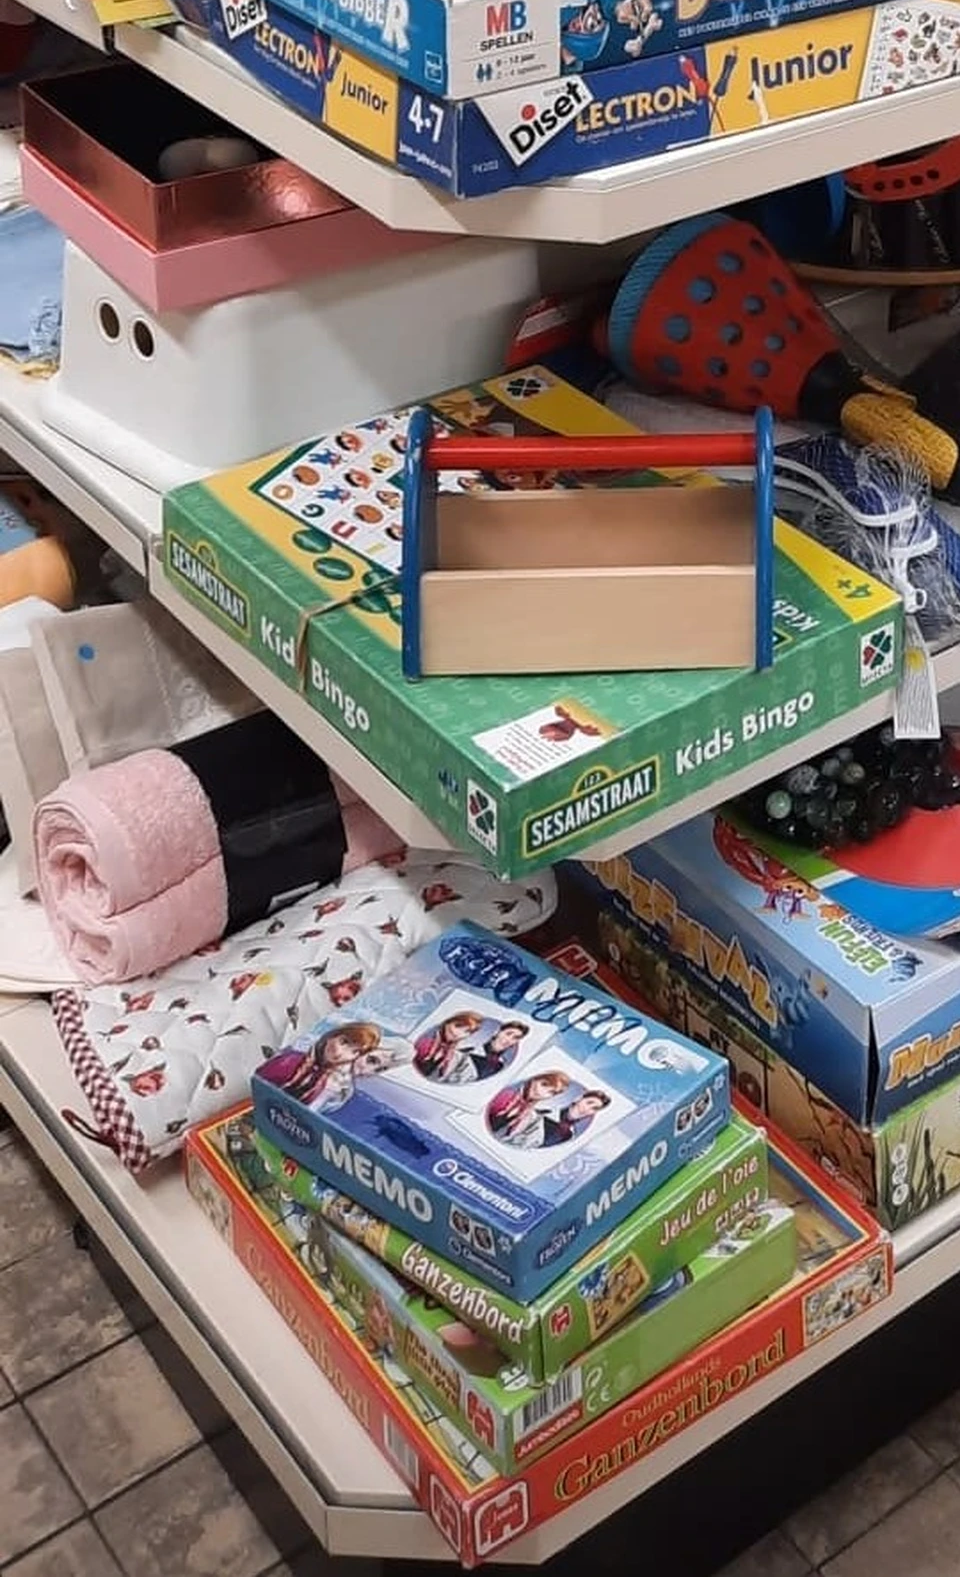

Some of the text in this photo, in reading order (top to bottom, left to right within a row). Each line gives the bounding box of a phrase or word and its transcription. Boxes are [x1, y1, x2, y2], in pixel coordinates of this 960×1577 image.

[480, 30, 534, 52] SPELLEN
[486, 0, 527, 36] MB
[339, 77, 390, 116] Junior
[510, 79, 581, 155] Diset
[576, 85, 698, 134] LECTRON
[751, 40, 853, 101] Junior
[172, 541, 245, 626] SESAMSTRAAT
[261, 616, 370, 733] Kid Bingo
[675, 691, 815, 776] Kids Bingo
[530, 767, 653, 847] SESAMSTRAAT
[322, 1133, 433, 1223] MEMO
[453, 1171, 529, 1221] Clementoni
[586, 1140, 668, 1226] MEMO
[660, 1208, 692, 1247] Jeu
[696, 1186, 718, 1215] de
[722, 1155, 760, 1195] l'oie
[402, 1241, 526, 1345] Ganzenbord
[554, 1326, 787, 1502] Ganzenbord
